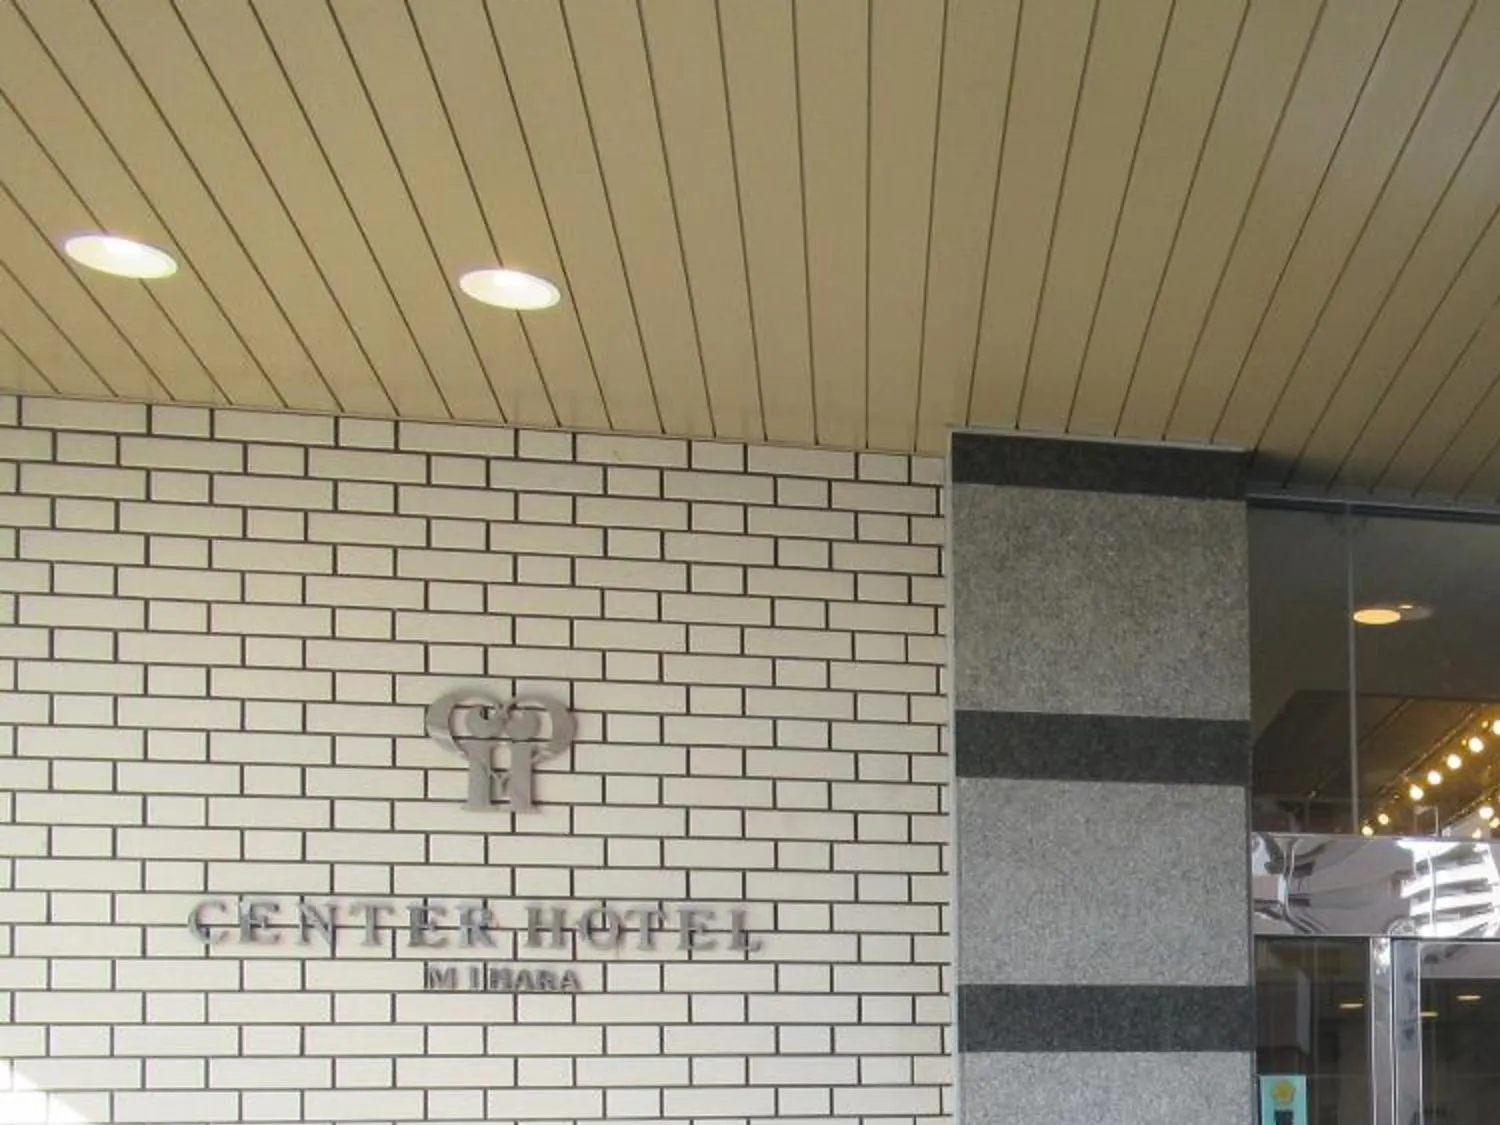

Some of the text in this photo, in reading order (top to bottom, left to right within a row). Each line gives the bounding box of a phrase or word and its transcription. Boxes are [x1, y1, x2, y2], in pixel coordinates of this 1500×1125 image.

[187, 900, 764, 954] CENTER HOTEL
[426, 963, 583, 991] MIHARA
